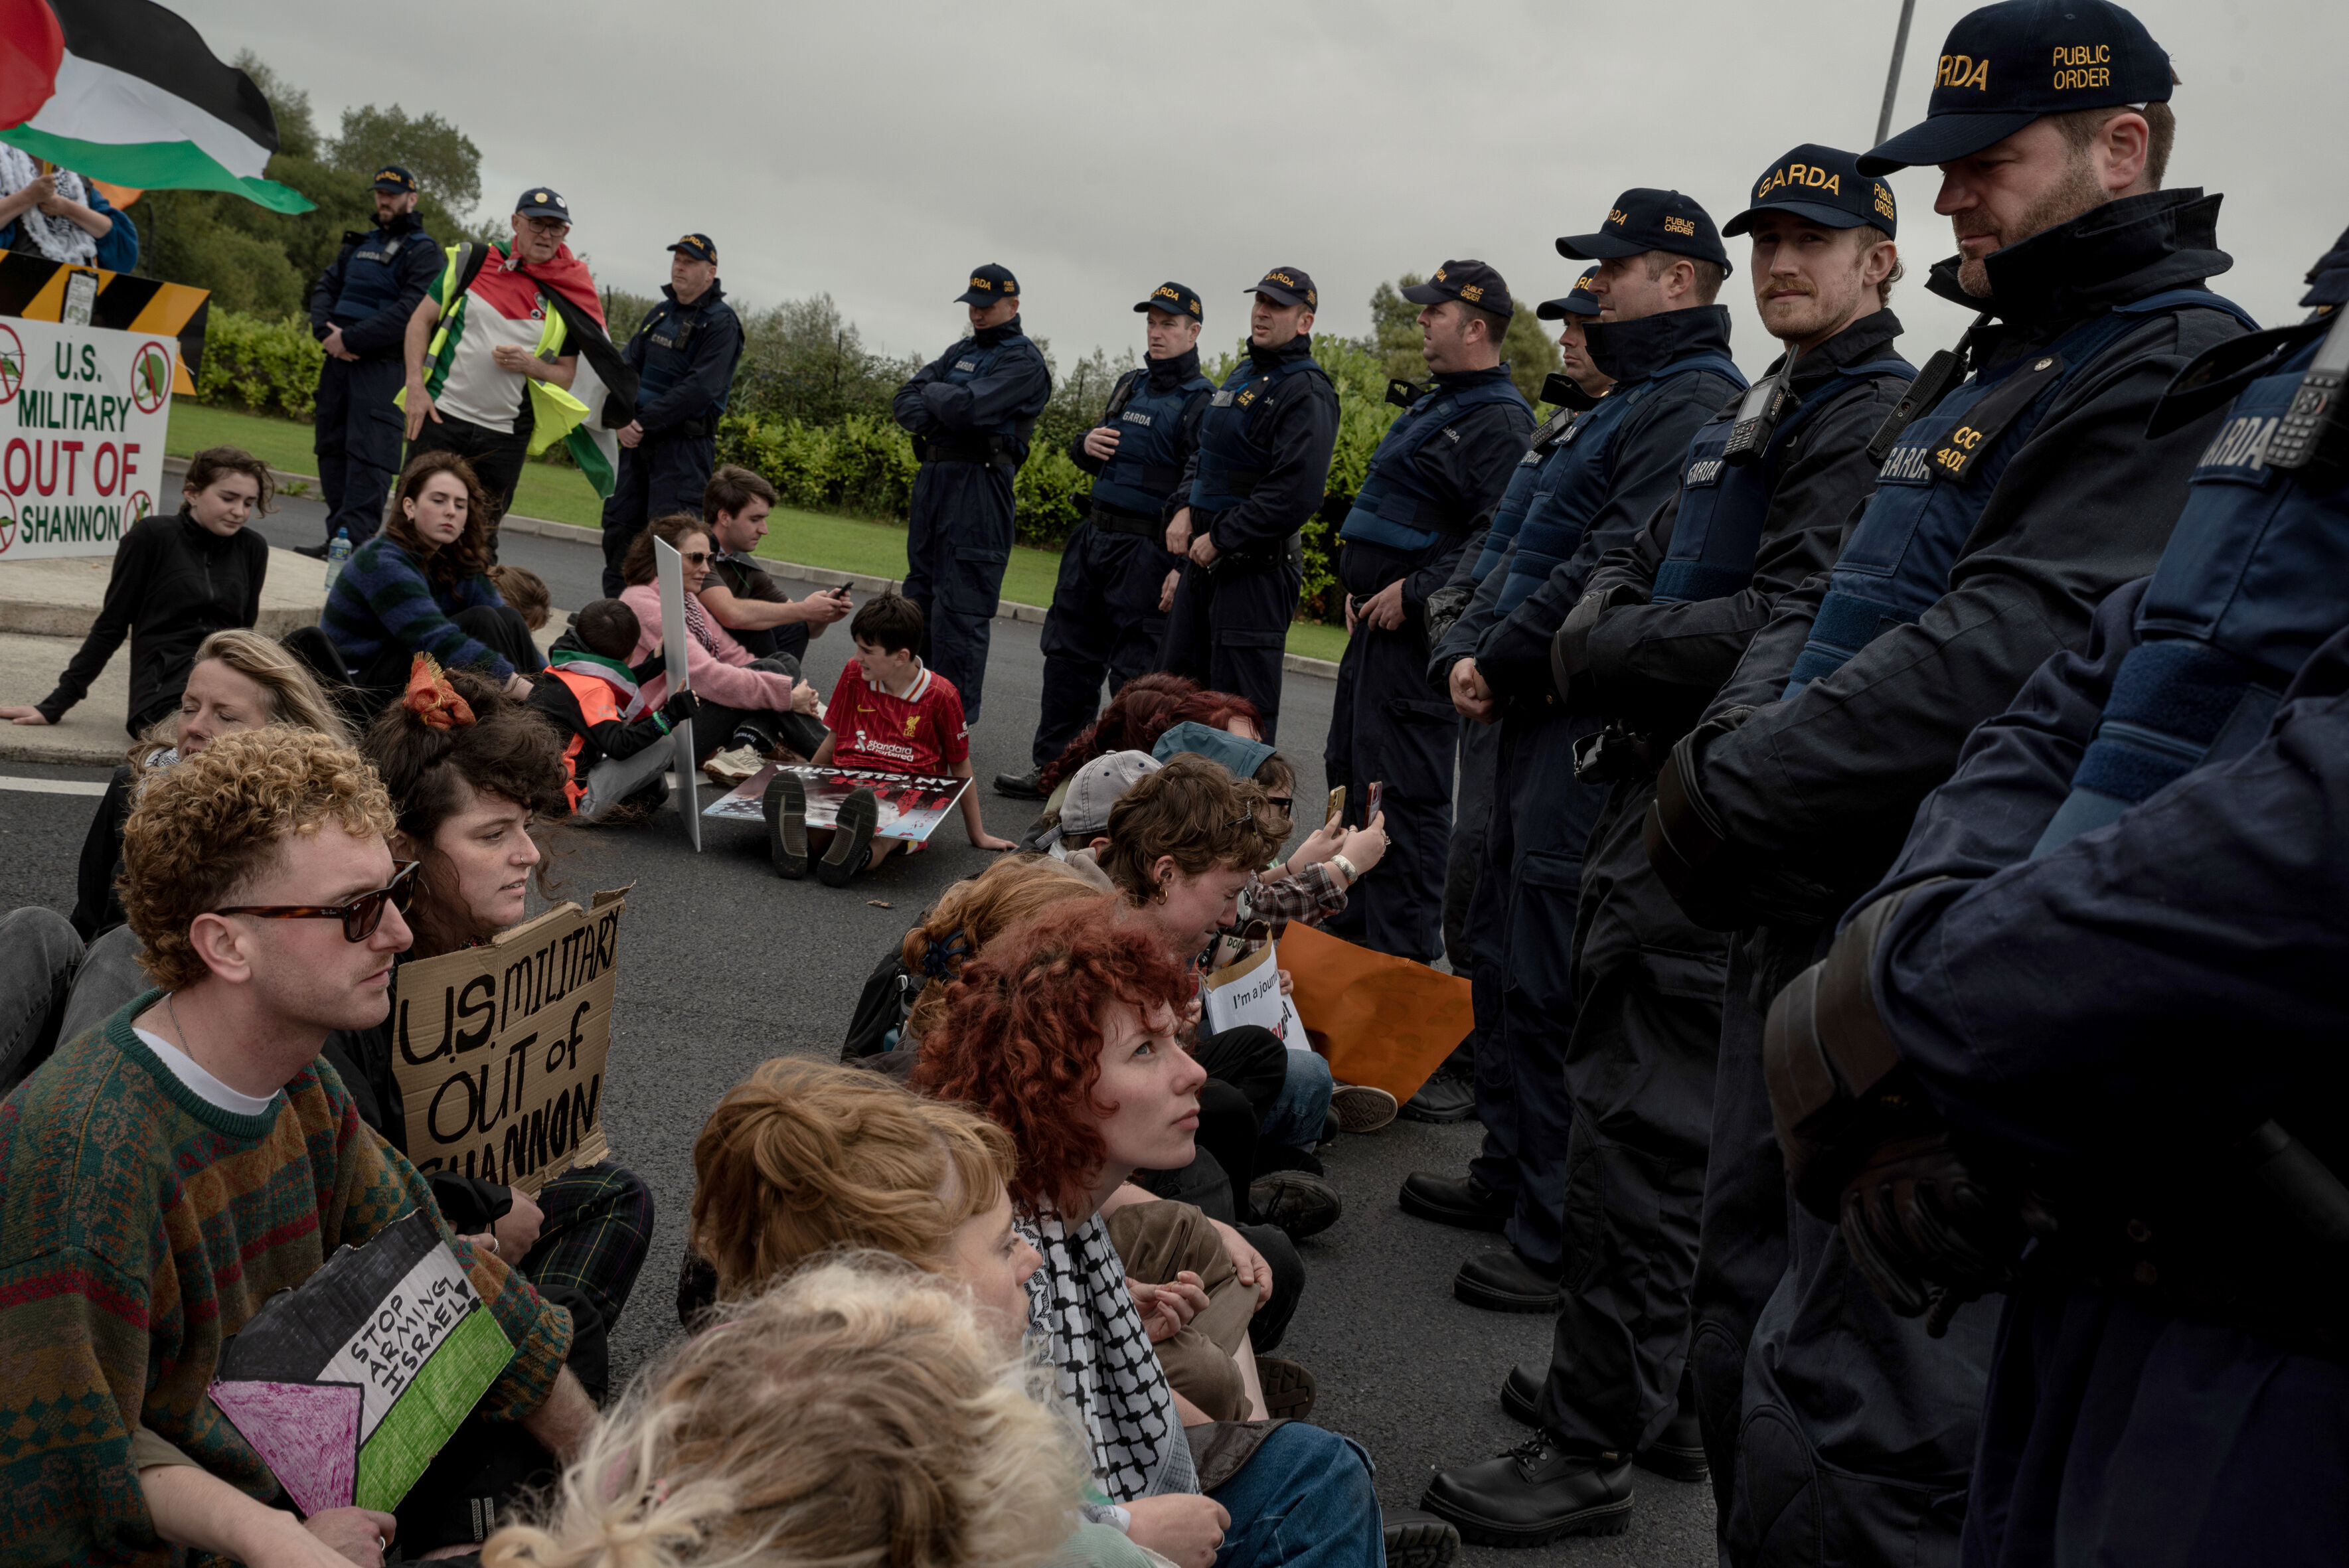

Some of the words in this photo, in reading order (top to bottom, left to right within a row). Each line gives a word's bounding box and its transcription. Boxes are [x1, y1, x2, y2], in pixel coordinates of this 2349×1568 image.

[2053, 44, 2110, 66] PUBLIC
[1935, 55, 1989, 91] RDA
[2054, 68, 2109, 90] ORDER
[1758, 164, 1840, 198] GARDA
[1874, 183, 1893, 206] PUBLIC
[1607, 209, 1627, 226] RDA
[1665, 216, 1694, 228] PUBLIC
[1875, 199, 1894, 222] ORDER
[1664, 224, 1694, 236] ORDER
[971, 277, 991, 290] ARDA
[1463, 283, 1484, 295] PUBLIC
[1461, 289, 1481, 302] ORDER
[56, 341, 102, 382] U.S.
[18, 390, 131, 431] MILITARY
[1123, 411, 1151, 426] GARDA
[1953, 426, 1983, 449] CC
[2200, 416, 2280, 471] ARDA
[4, 437, 84, 497] OUT
[94, 441, 141, 497] OF
[1936, 447, 1967, 472] 401
[1687, 460, 1722, 485] GARDA
[21, 505, 121, 543] SHANNON
[868, 740, 913, 755] standard
[829, 777, 892, 789] JOE
[914, 776, 958, 787] AN
[398, 973, 497, 1065] U.S.
[500, 906, 621, 1033] MILITARY
[1252, 987, 1257, 999] a
[427, 1032, 538, 1144] OUT
[546, 1000, 592, 1073] of
[351, 1294, 402, 1364] STOP
[370, 1277, 454, 1383] ARMING
[381, 1279, 481, 1396] ISRAEL!
